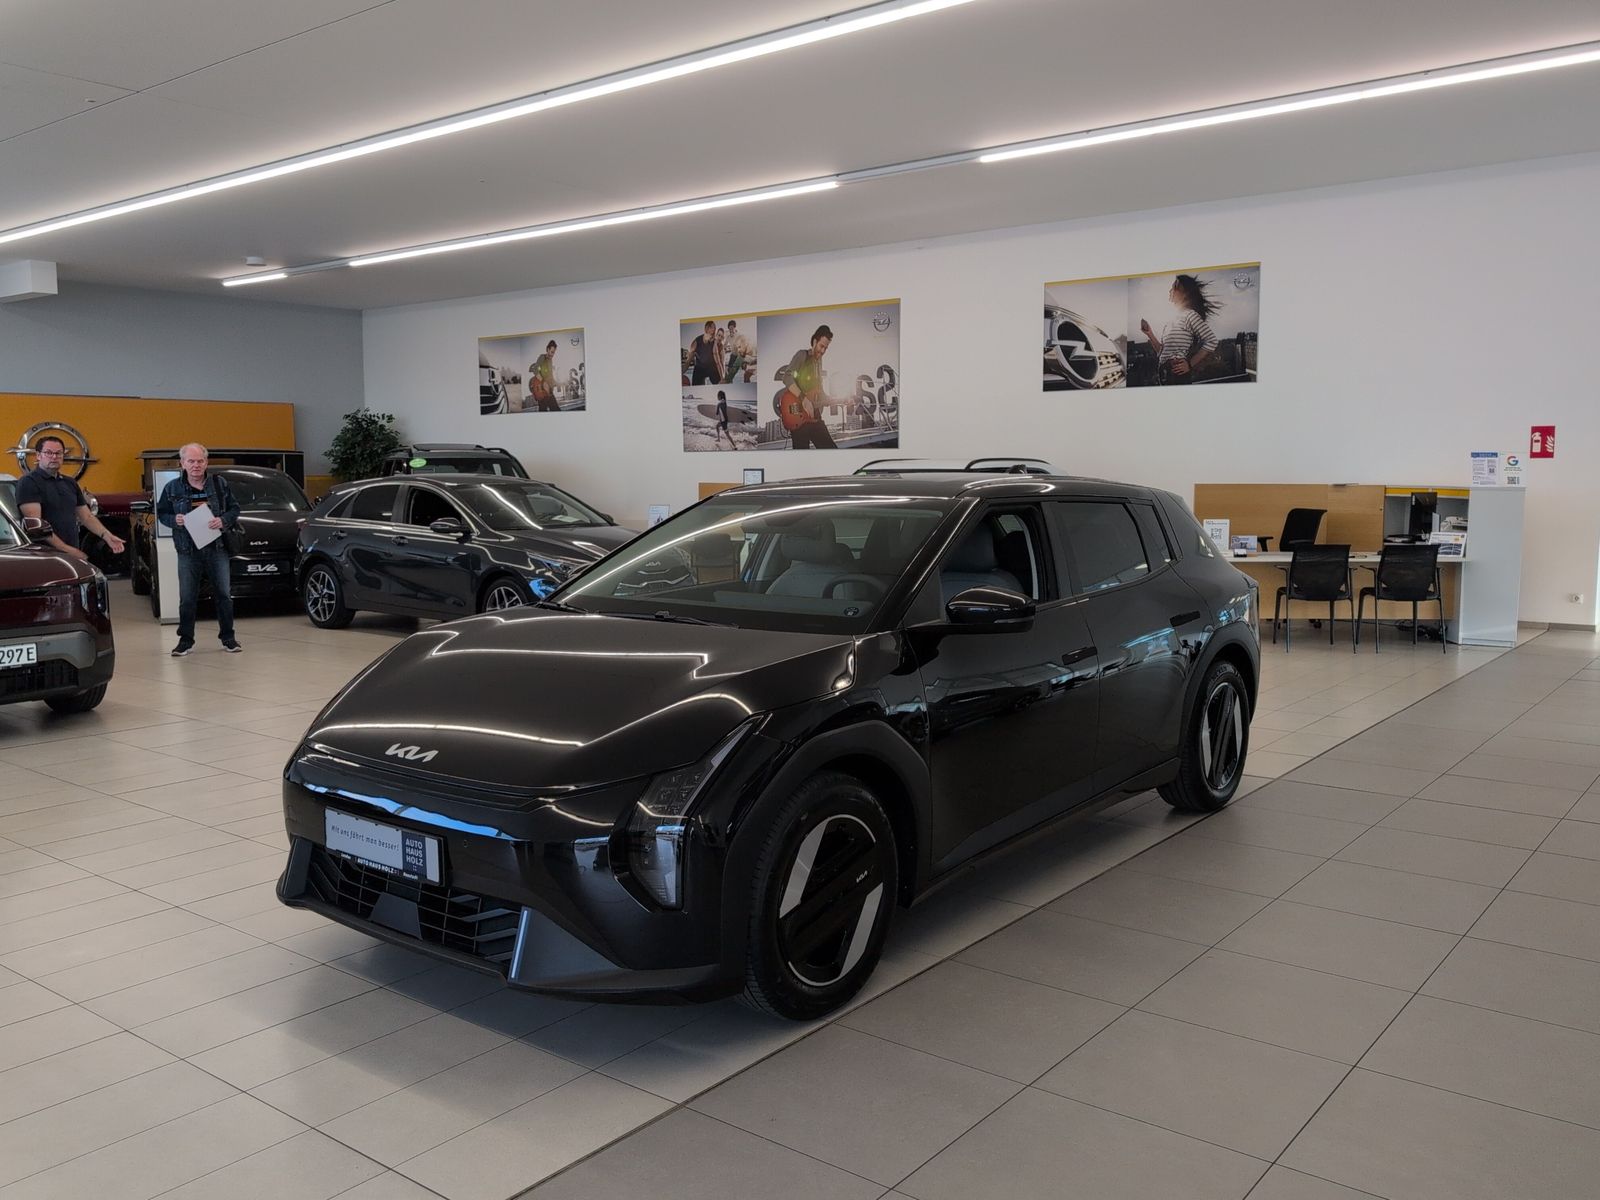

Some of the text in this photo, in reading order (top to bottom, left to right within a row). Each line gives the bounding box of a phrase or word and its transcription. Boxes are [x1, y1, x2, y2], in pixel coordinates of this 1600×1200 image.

[247, 564, 278, 572] EV6
[385, 742, 439, 762] KIA
[366, 836, 377, 846] man
[405, 838, 423, 849] AUTO
[405, 847, 423, 858] HAUS
[406, 856, 424, 866] HOLZ
